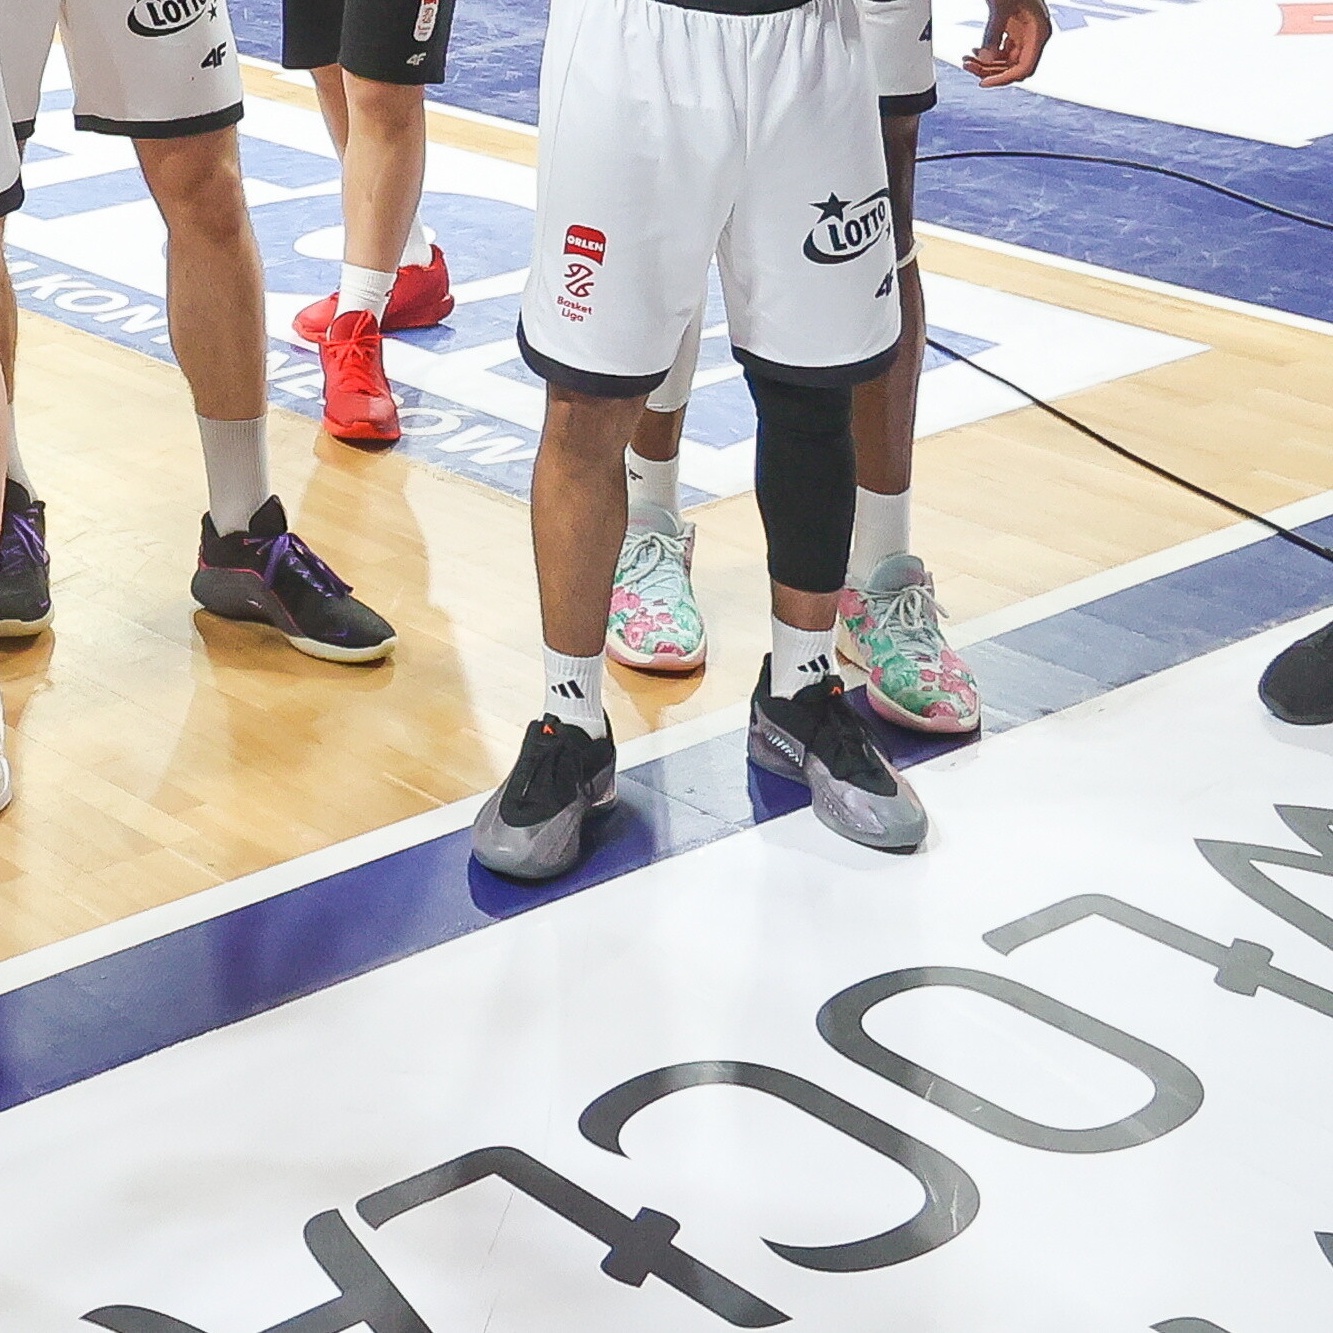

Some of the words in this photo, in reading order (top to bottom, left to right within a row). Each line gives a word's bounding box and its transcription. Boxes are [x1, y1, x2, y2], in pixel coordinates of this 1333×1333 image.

[200, 41, 230, 70] 4F
[405, 52, 427, 66] 4F
[828, 201, 888, 252] LOTTO
[565, 234, 605, 253] ORLEN
[557, 296, 593, 315] Basket
[561, 308, 585, 322] Liga
